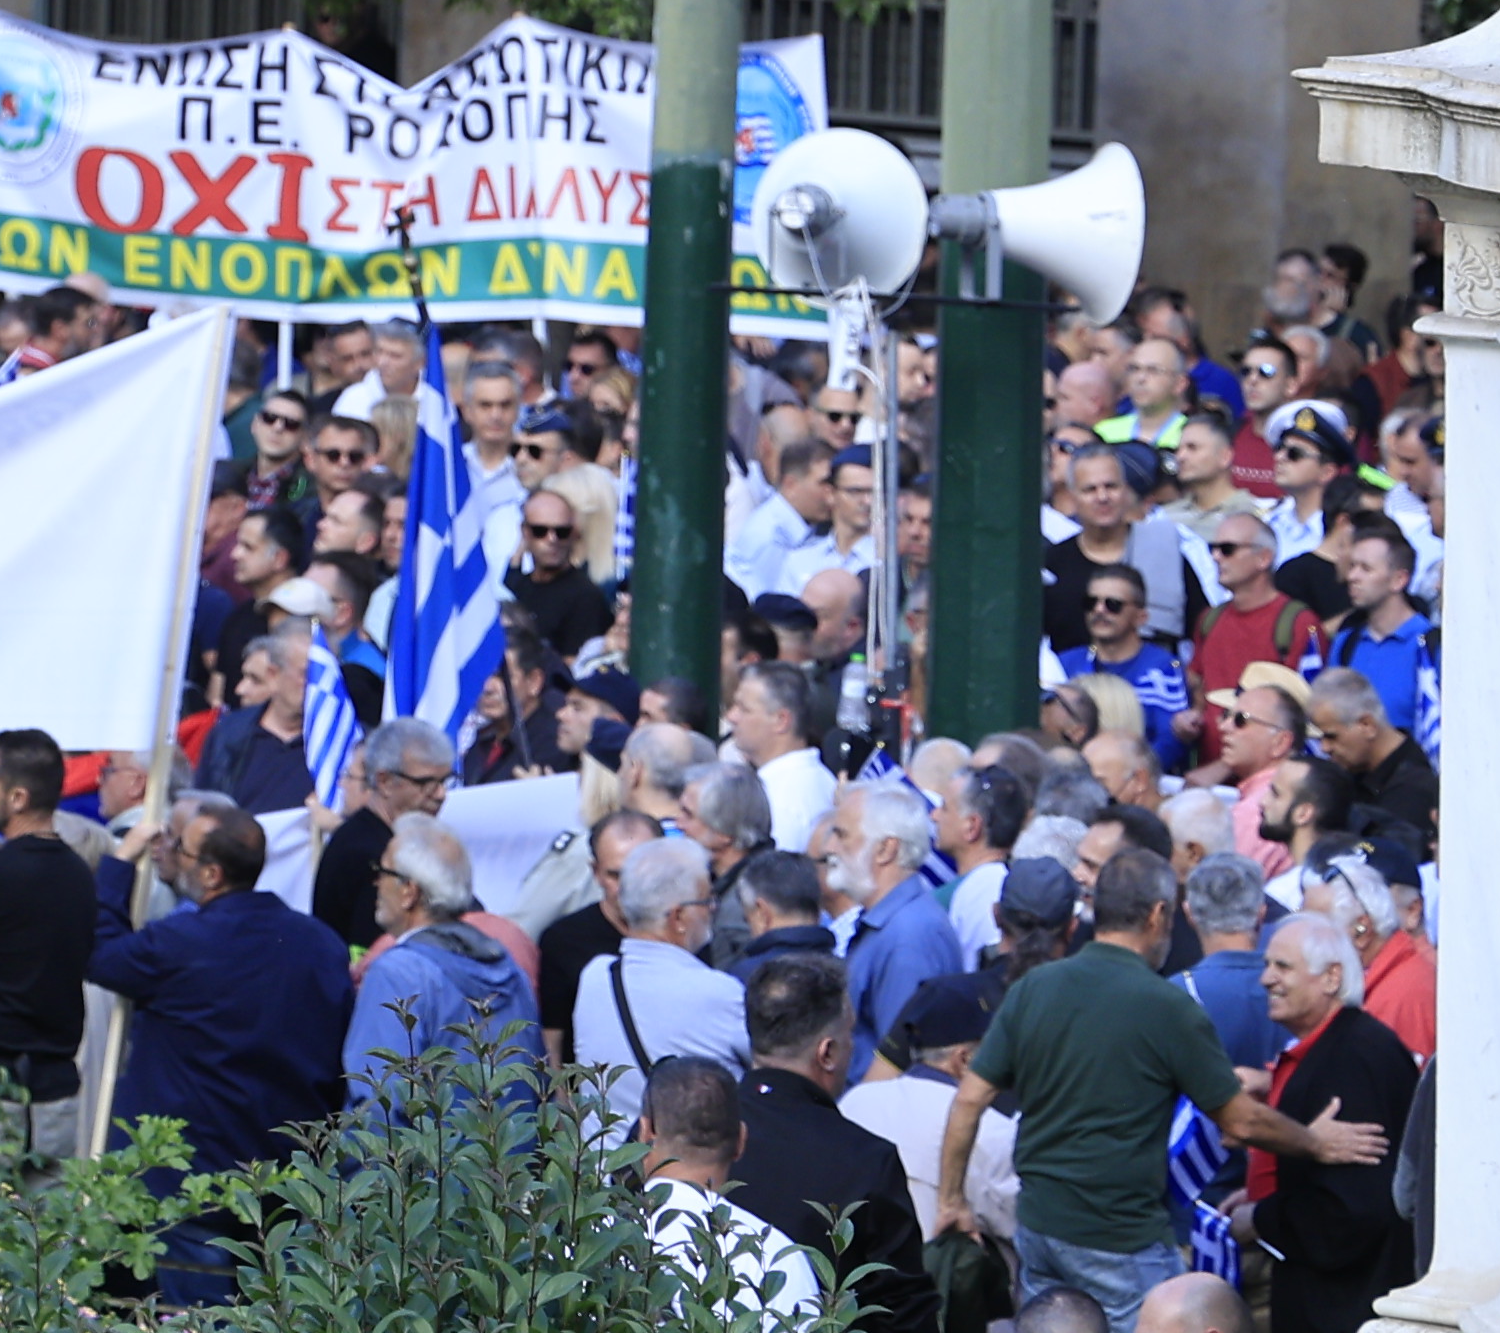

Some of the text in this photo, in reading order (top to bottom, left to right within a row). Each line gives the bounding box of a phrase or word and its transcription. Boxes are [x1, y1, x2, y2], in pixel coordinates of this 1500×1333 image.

[94, 42, 289, 92] ΕΝΩΣΗ
[74, 146, 314, 244] ΟΧΙ
[123, 235, 462, 300] ΕΝΟΠΛΩΝ
